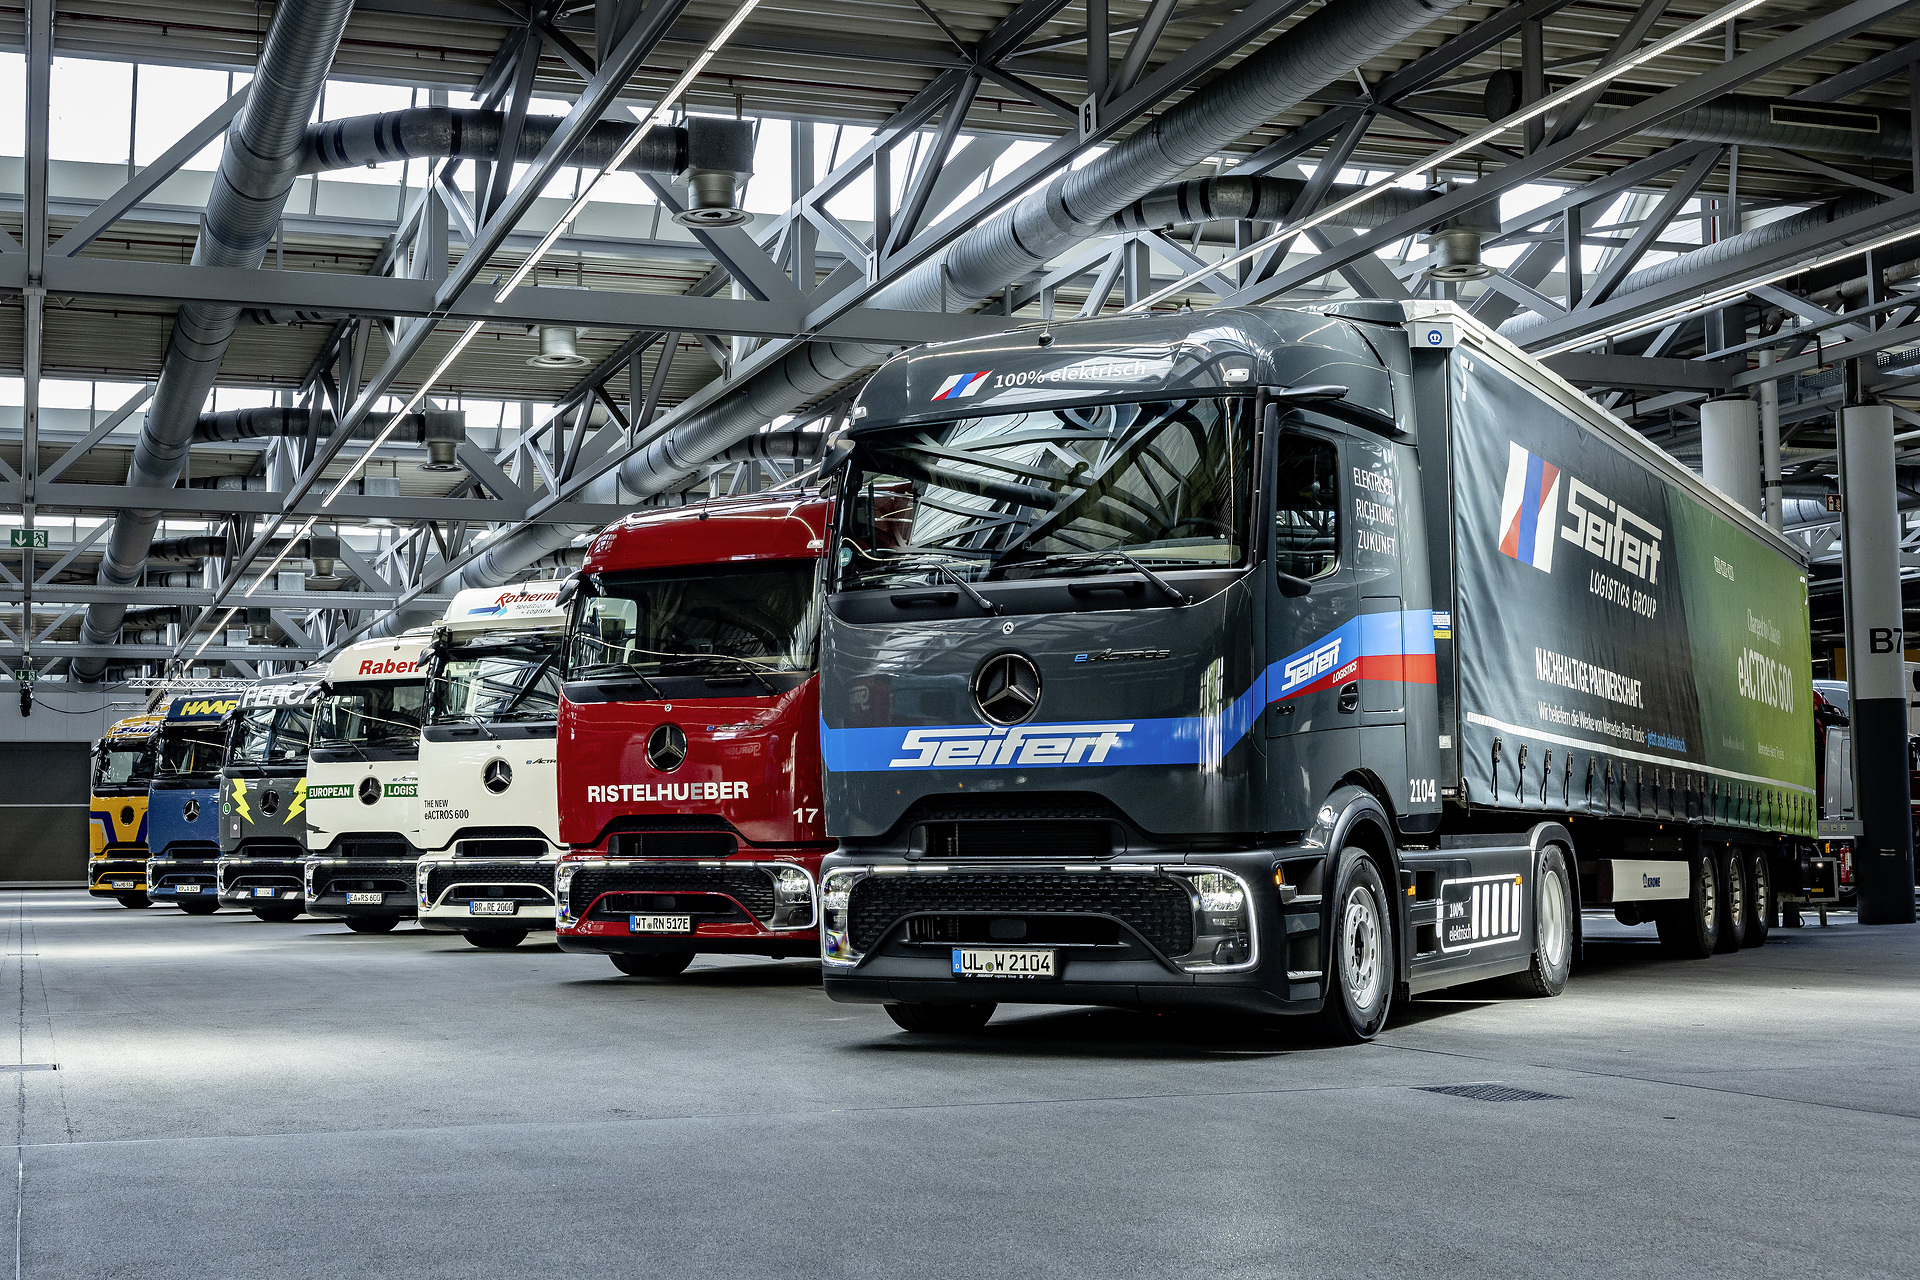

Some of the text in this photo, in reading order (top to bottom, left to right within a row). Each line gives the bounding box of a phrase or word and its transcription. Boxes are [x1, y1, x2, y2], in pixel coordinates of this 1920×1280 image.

[1084, 103, 1092, 134] 6
[993, 360, 1147, 389] 100% elektrisch
[1355, 498, 1395, 527] RICHTUNG
[1560, 476, 1663, 585] Seifert
[1589, 568, 1657, 620] LOGISTICS GROUP
[1281, 637, 1343, 692] Seifert
[1332, 660, 1358, 684] LOGISTICS
[1535, 646, 1589, 694] NACHHALTIGE
[1737, 646, 1794, 715] eACTROS 600
[888, 723, 1135, 768] Seifert
[308, 785, 351, 798] EUROPEAN
[587, 781, 749, 803] RISTELHUEBER
[1409, 778, 1437, 803] 2104
[424, 799, 449, 808] THE NEW
[424, 808, 470, 820] eACTROS 600
[792, 807, 819, 824] 17
[474, 902, 483, 912] BR
[486, 902, 495, 912] RE
[1449, 902, 1464, 918] 100%
[652, 917, 665, 930] RN
[666, 917, 689, 930] 517E
[1449, 923, 1472, 942] elektrisch
[962, 953, 984, 971] UL
[994, 953, 1005, 971] W
[1008, 954, 1051, 972] 2104
